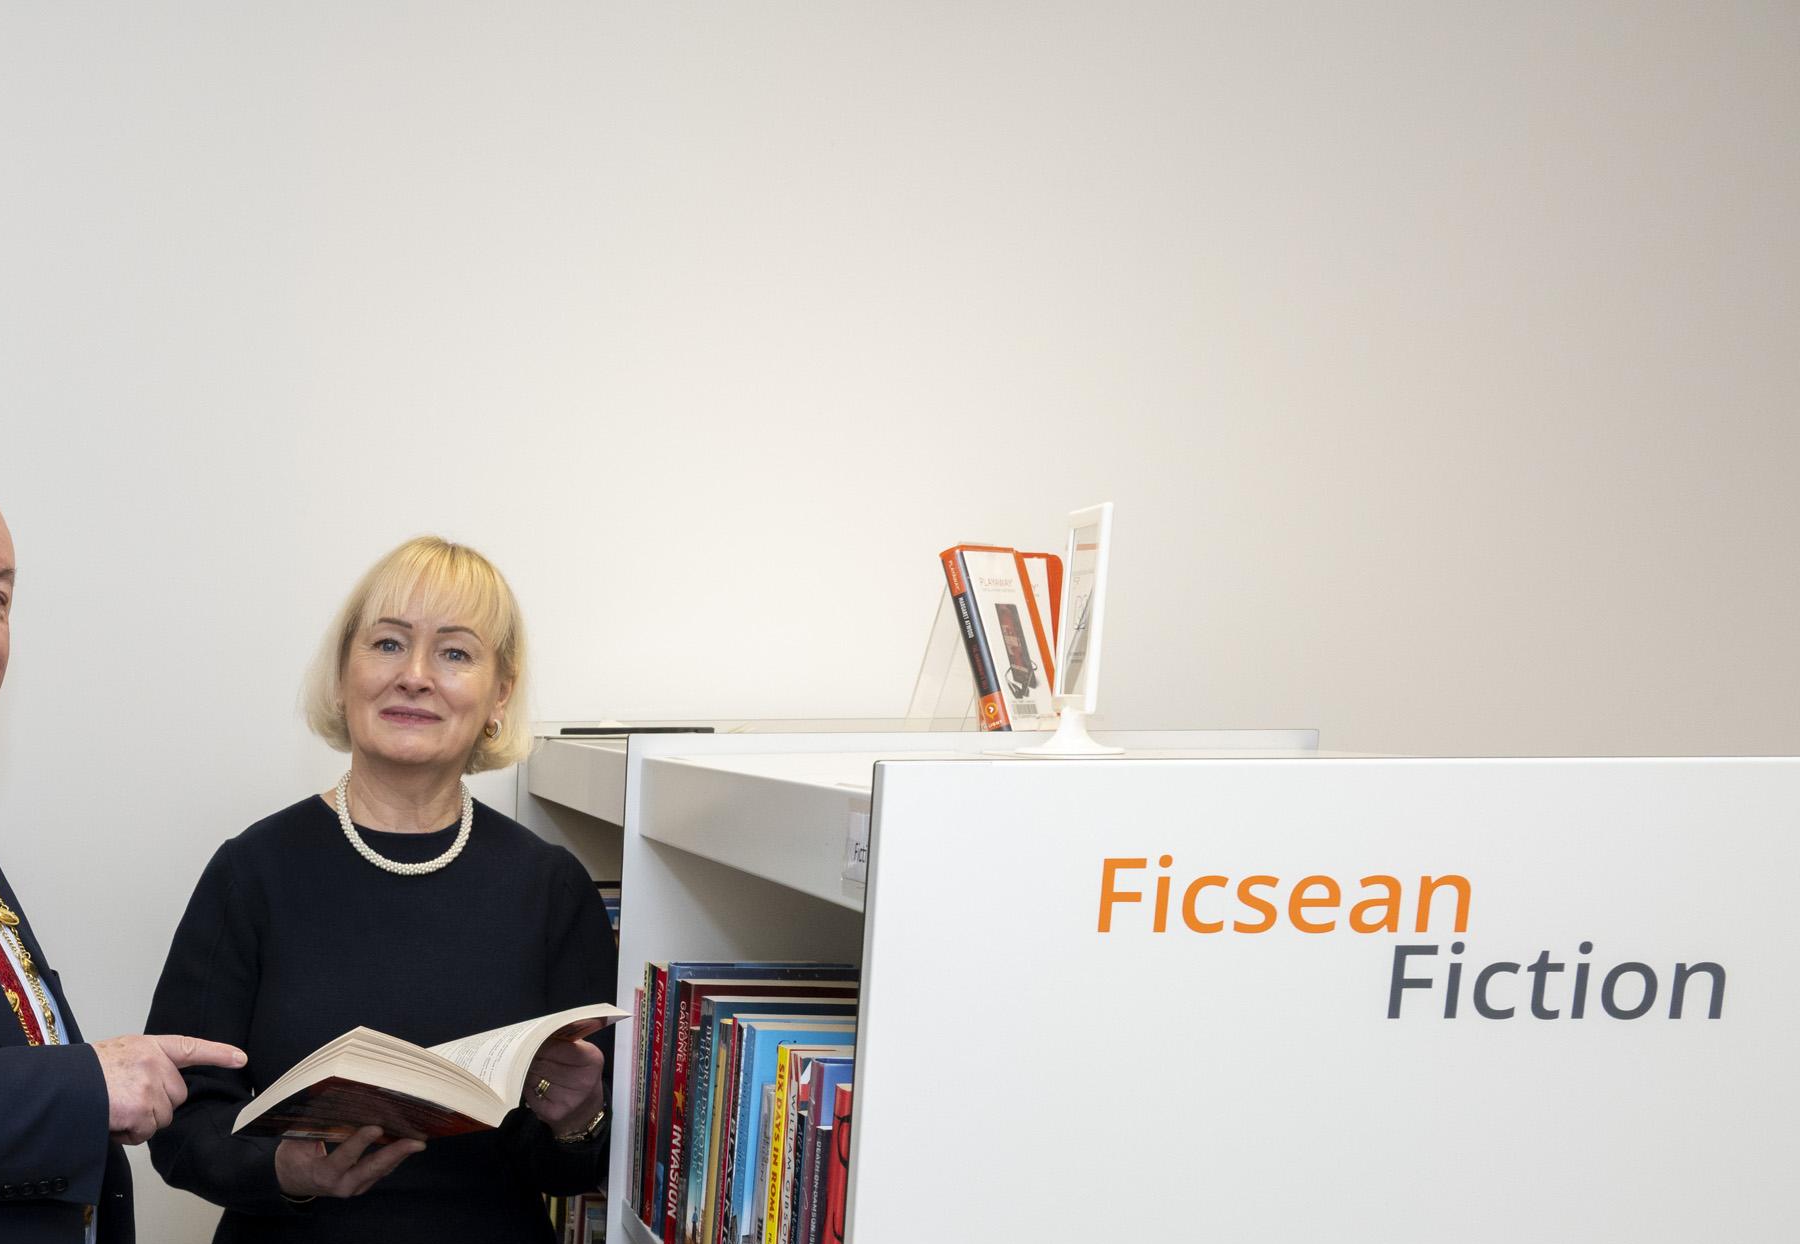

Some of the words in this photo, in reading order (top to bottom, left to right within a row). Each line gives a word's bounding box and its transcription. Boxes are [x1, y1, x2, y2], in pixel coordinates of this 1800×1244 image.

[948, 561, 960, 590] PLAYAWAY
[959, 597, 970, 619] MARGARET
[965, 621, 975, 638] ATWOOD
[1098, 854, 1471, 934] Ficsean
[1388, 942, 1725, 1020] Fiction
[676, 1001, 686, 1072] GARDNER
[697, 1038, 705, 1093] HAZEL
[701, 1025, 711, 1088] BEFORE
[692, 1098, 701, 1169] GAYNOR
[696, 1094, 708, 1184] DOROTHY
[774, 1096, 783, 1139] DAYS
[787, 1092, 796, 1169] WILLIAM
[667, 1125, 682, 1218] INVASION
[726, 1118, 736, 1195] BLACK
[773, 1145, 779, 1163] IN
[814, 1172, 819, 1186] ON
[769, 1169, 778, 1221] ROME
[810, 1189, 818, 1227] DAMSON
